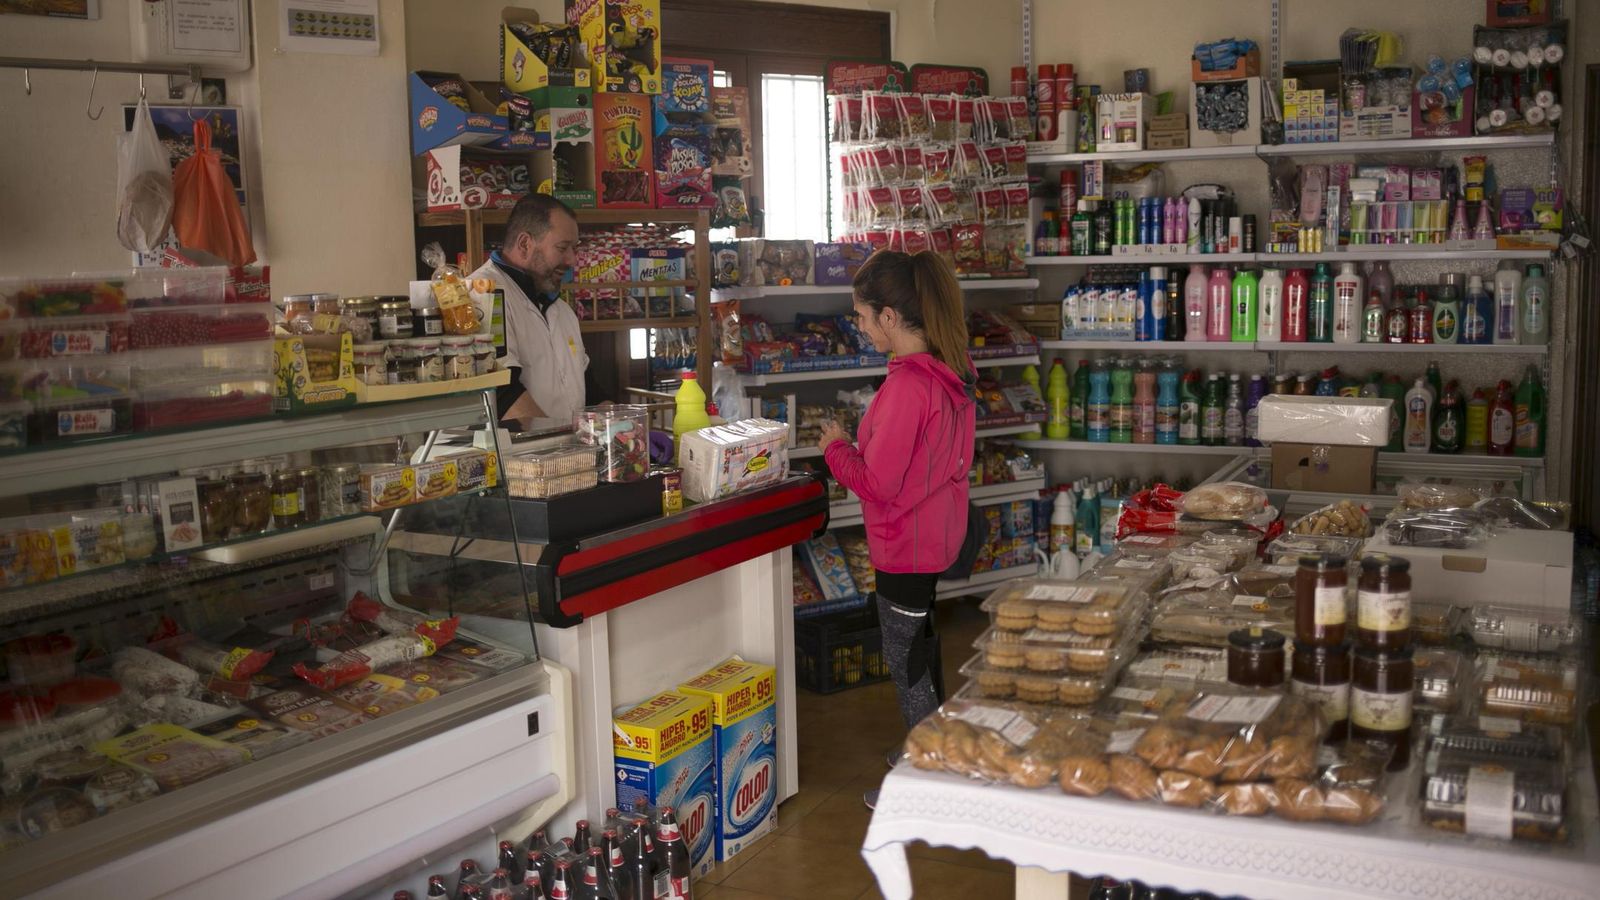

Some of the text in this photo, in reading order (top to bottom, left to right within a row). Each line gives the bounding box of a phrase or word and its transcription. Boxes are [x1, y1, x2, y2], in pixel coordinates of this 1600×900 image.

[675, 84, 702, 97] KOJAK
[727, 677, 771, 706] HIPER 95
[726, 697, 751, 715] AHORRO
[660, 719, 685, 743] HIPER
[691, 708, 707, 734] 95
[635, 736, 649, 750] 95
[660, 733, 686, 753] AHORRO
[735, 764, 769, 817] COLON
[679, 801, 705, 846] OLON
